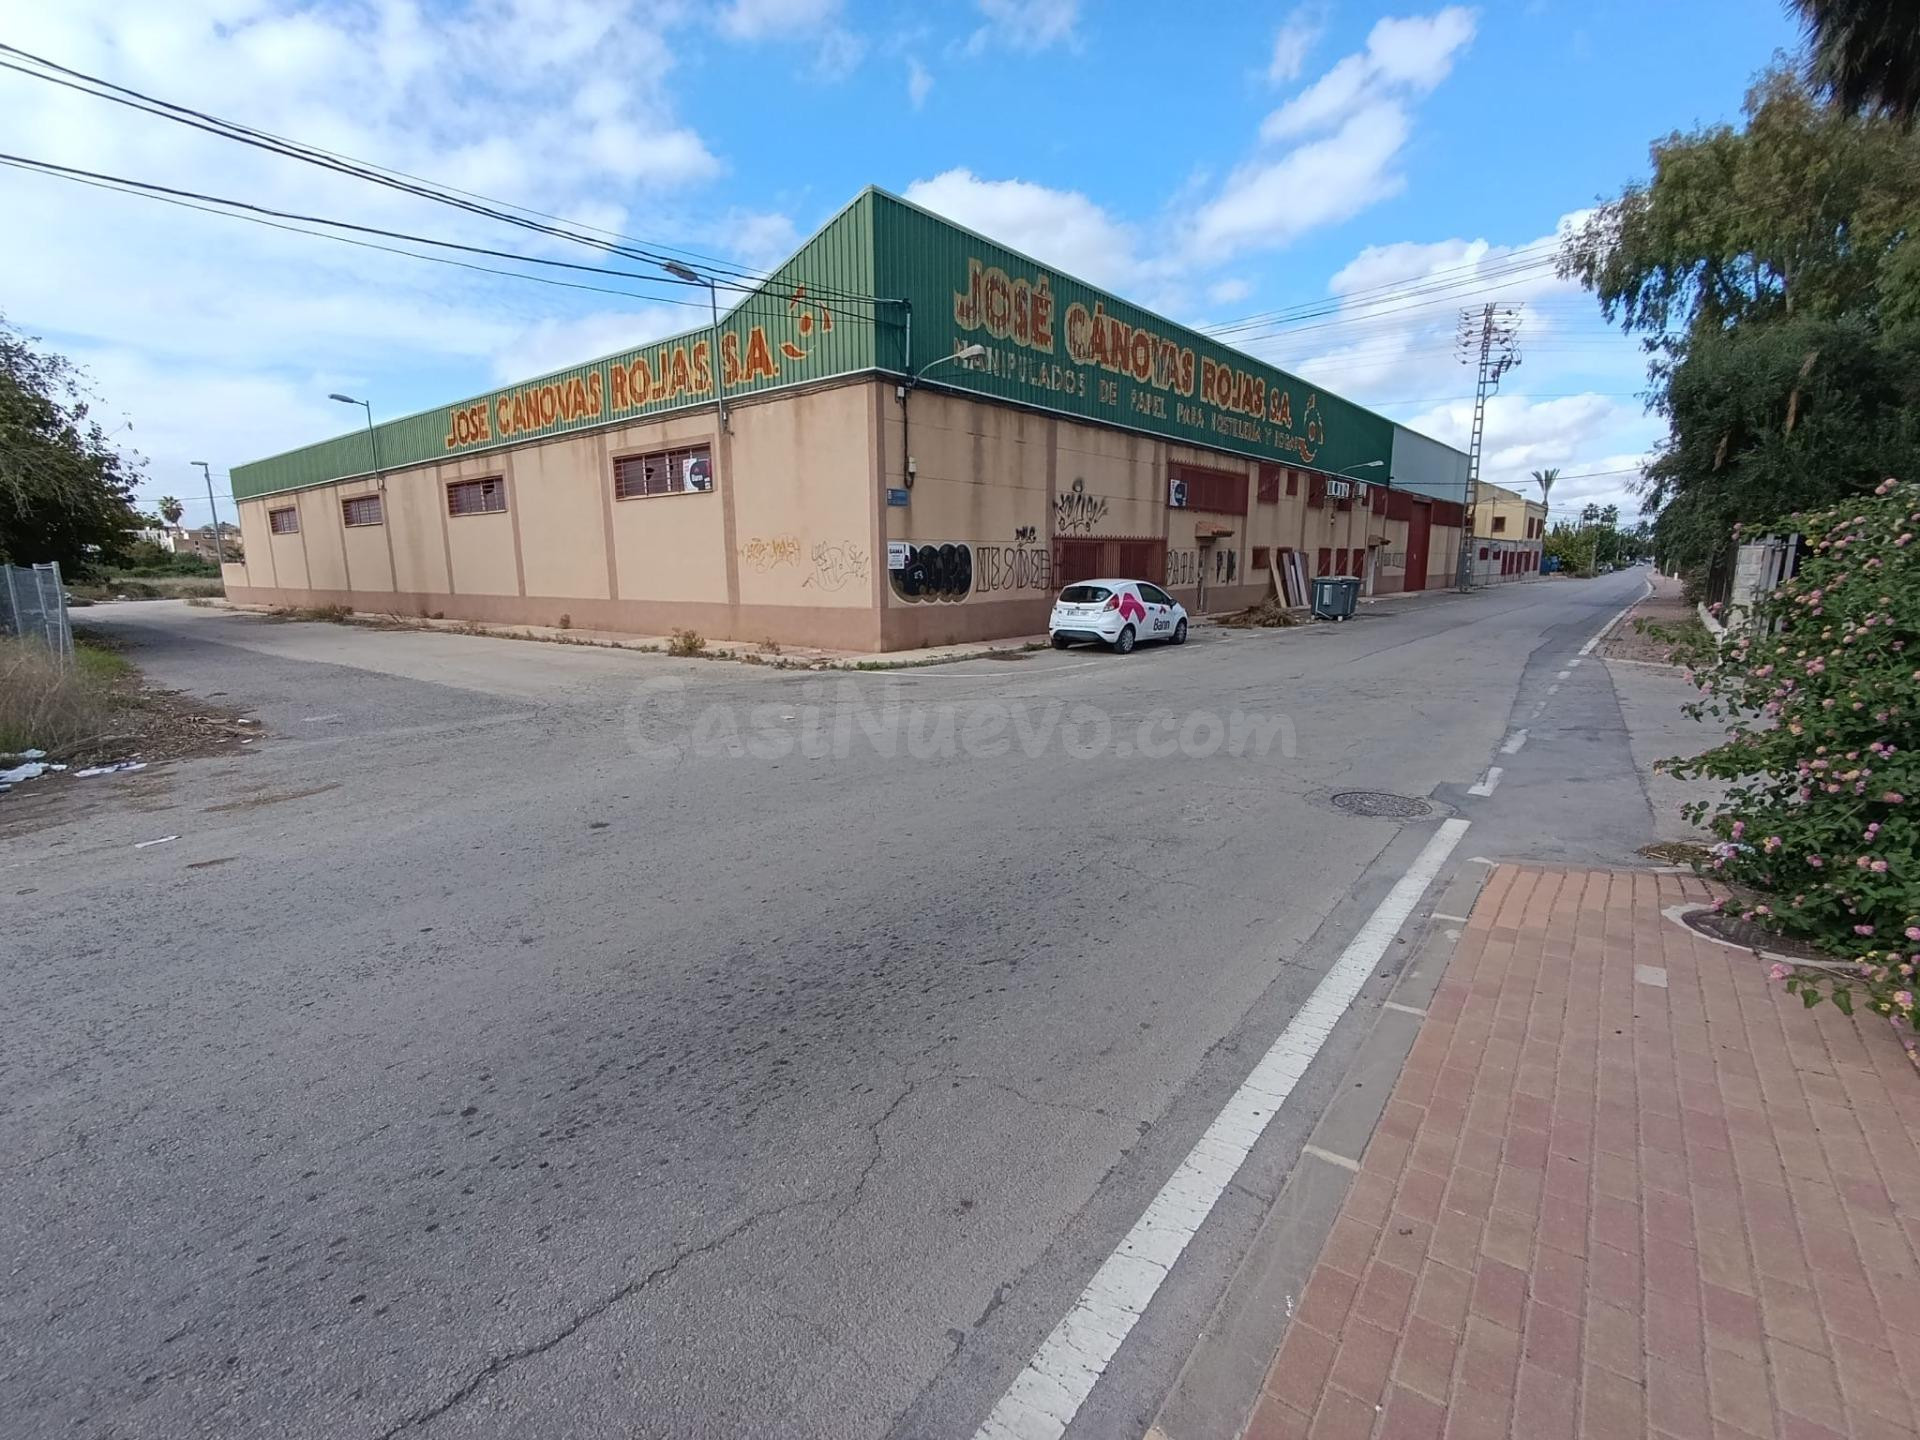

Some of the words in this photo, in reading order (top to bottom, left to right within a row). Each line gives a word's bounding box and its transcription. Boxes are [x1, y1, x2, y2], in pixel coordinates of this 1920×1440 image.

[953, 257, 1055, 354] JOSÉ
[446, 403, 489, 448] JOSE
[496, 371, 602, 437] CANOVAS
[720, 325, 780, 388] S.A.
[1099, 379, 1118, 406] DE
[1130, 389, 1168, 420] PAPEL
[1176, 402, 1205, 429] PARA
[1153, 617, 1170, 632] Bann
